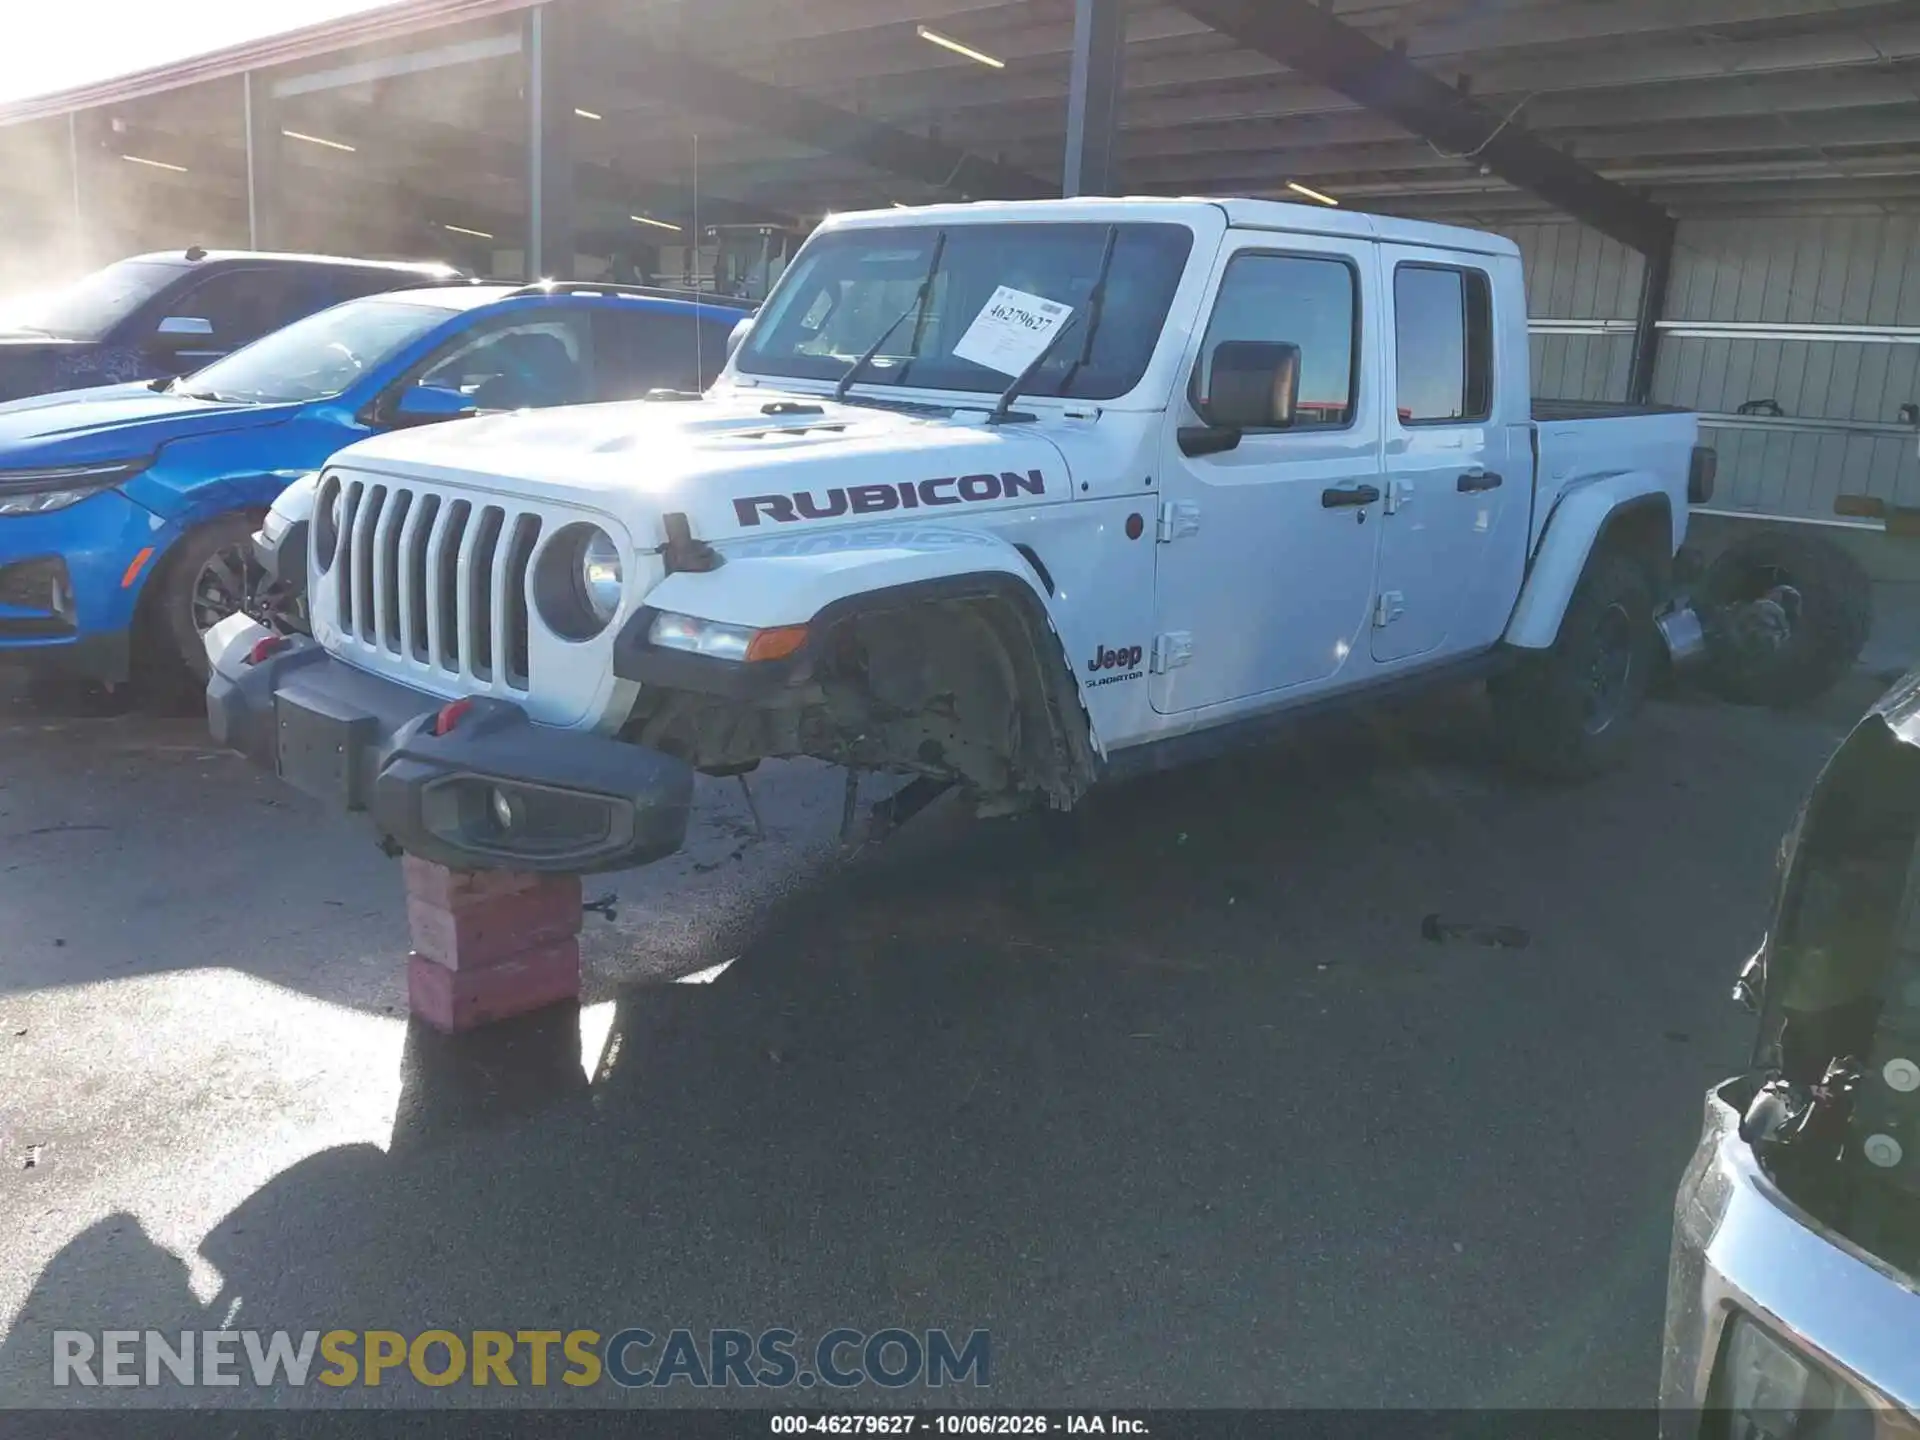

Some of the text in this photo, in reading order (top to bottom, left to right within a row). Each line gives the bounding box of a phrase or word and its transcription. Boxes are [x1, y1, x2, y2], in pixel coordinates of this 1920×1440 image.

[990, 304, 1052, 331] 46279627
[733, 469, 1046, 526] RUBICON
[1088, 644, 1142, 671] Jeep
[1085, 671, 1143, 688] GLADIATOR
